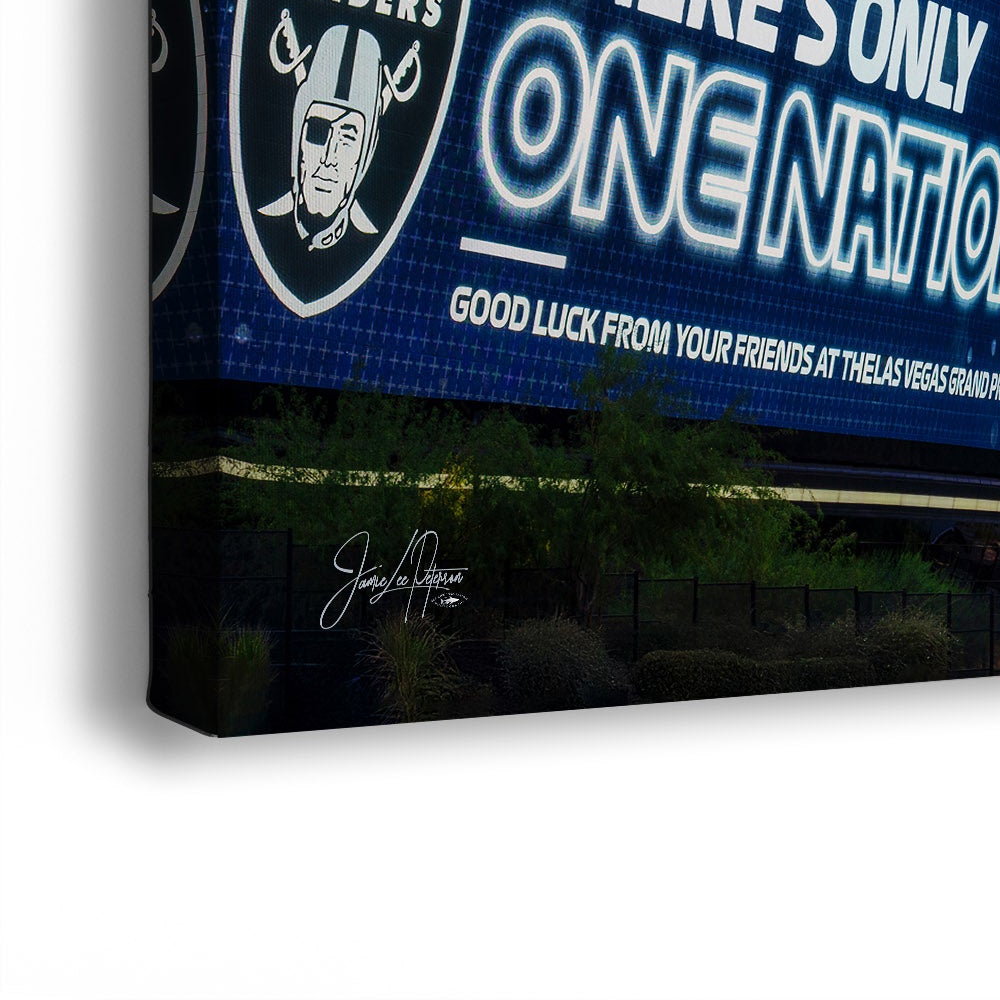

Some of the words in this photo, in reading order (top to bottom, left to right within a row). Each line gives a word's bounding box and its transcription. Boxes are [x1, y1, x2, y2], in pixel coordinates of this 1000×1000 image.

[480, 14, 768, 250] ONE
[449, 285, 531, 332] GOOD
[532, 299, 601, 344] LUCK
[600, 311, 672, 355] FROM
[676, 323, 733, 364] YOUR
[732, 334, 815, 375] FRIENDS
[813, 345, 842, 379] AT
[903, 359, 949, 394] VEGAS
[948, 367, 989, 400] GRAND
